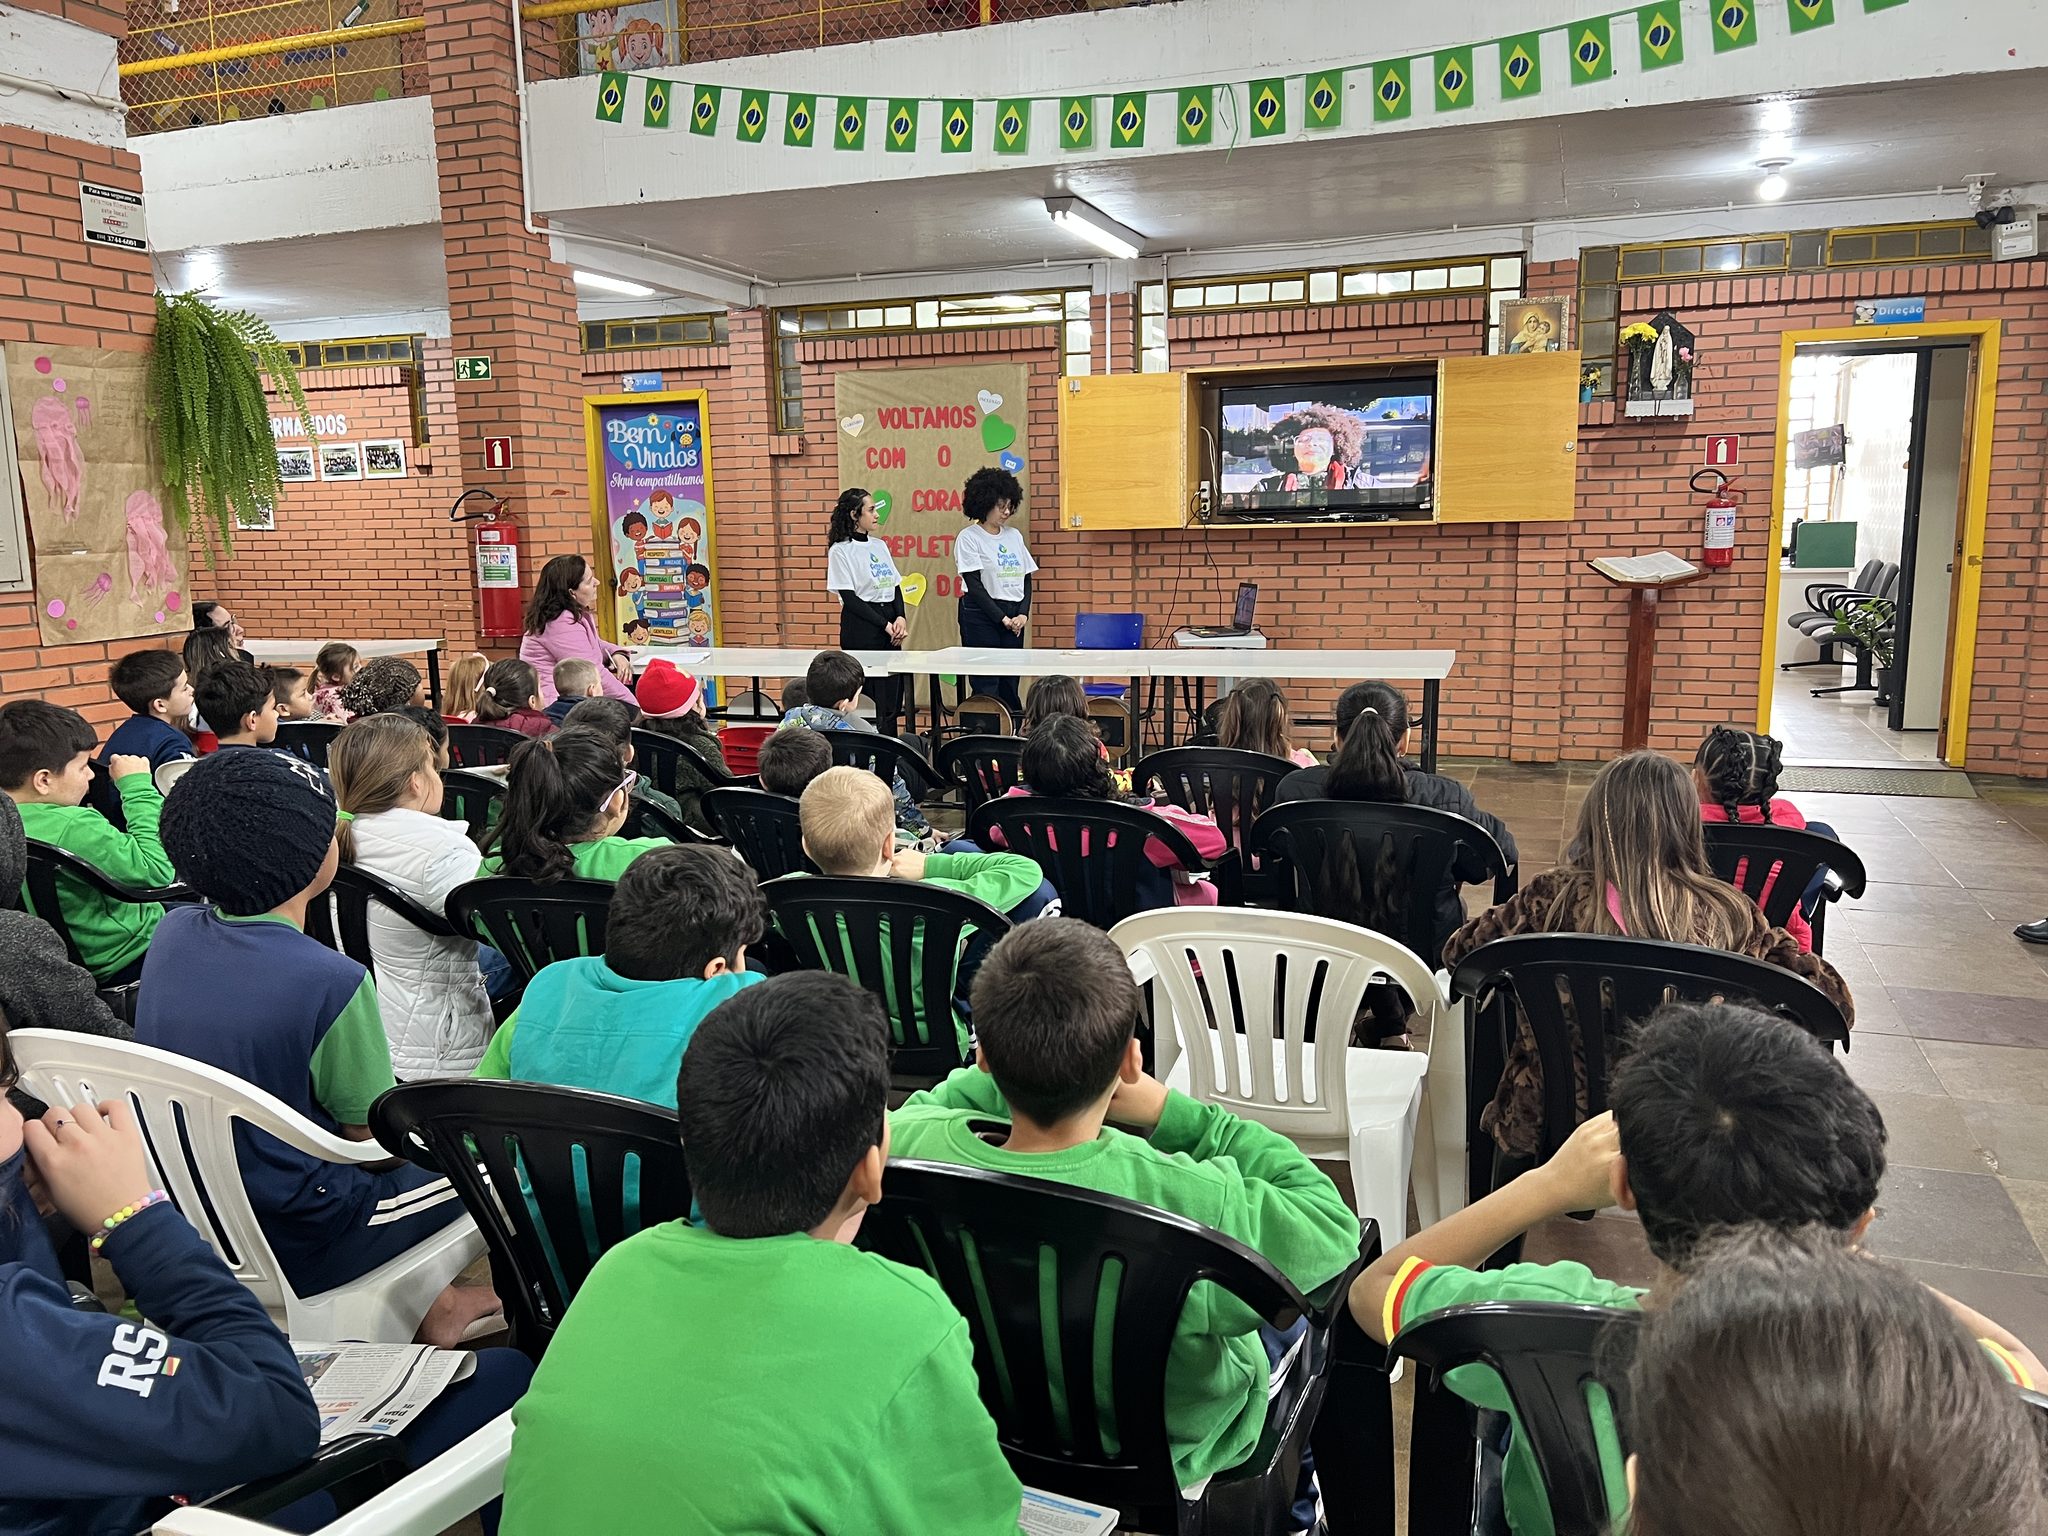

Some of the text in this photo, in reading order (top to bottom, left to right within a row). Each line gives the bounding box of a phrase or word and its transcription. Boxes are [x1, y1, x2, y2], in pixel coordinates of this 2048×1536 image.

[1878, 305, 1923, 316] Direção
[269, 414, 348, 438] RMADOS
[877, 405, 977, 430] VOLTAMOS
[606, 419, 667, 444] Bem
[623, 441, 698, 469] Vindos
[865, 444, 952, 470] COM O
[610, 472, 704, 490] Aqui compartilhamos
[911, 489, 964, 513] CORA
[97, 1323, 168, 1398] RS
